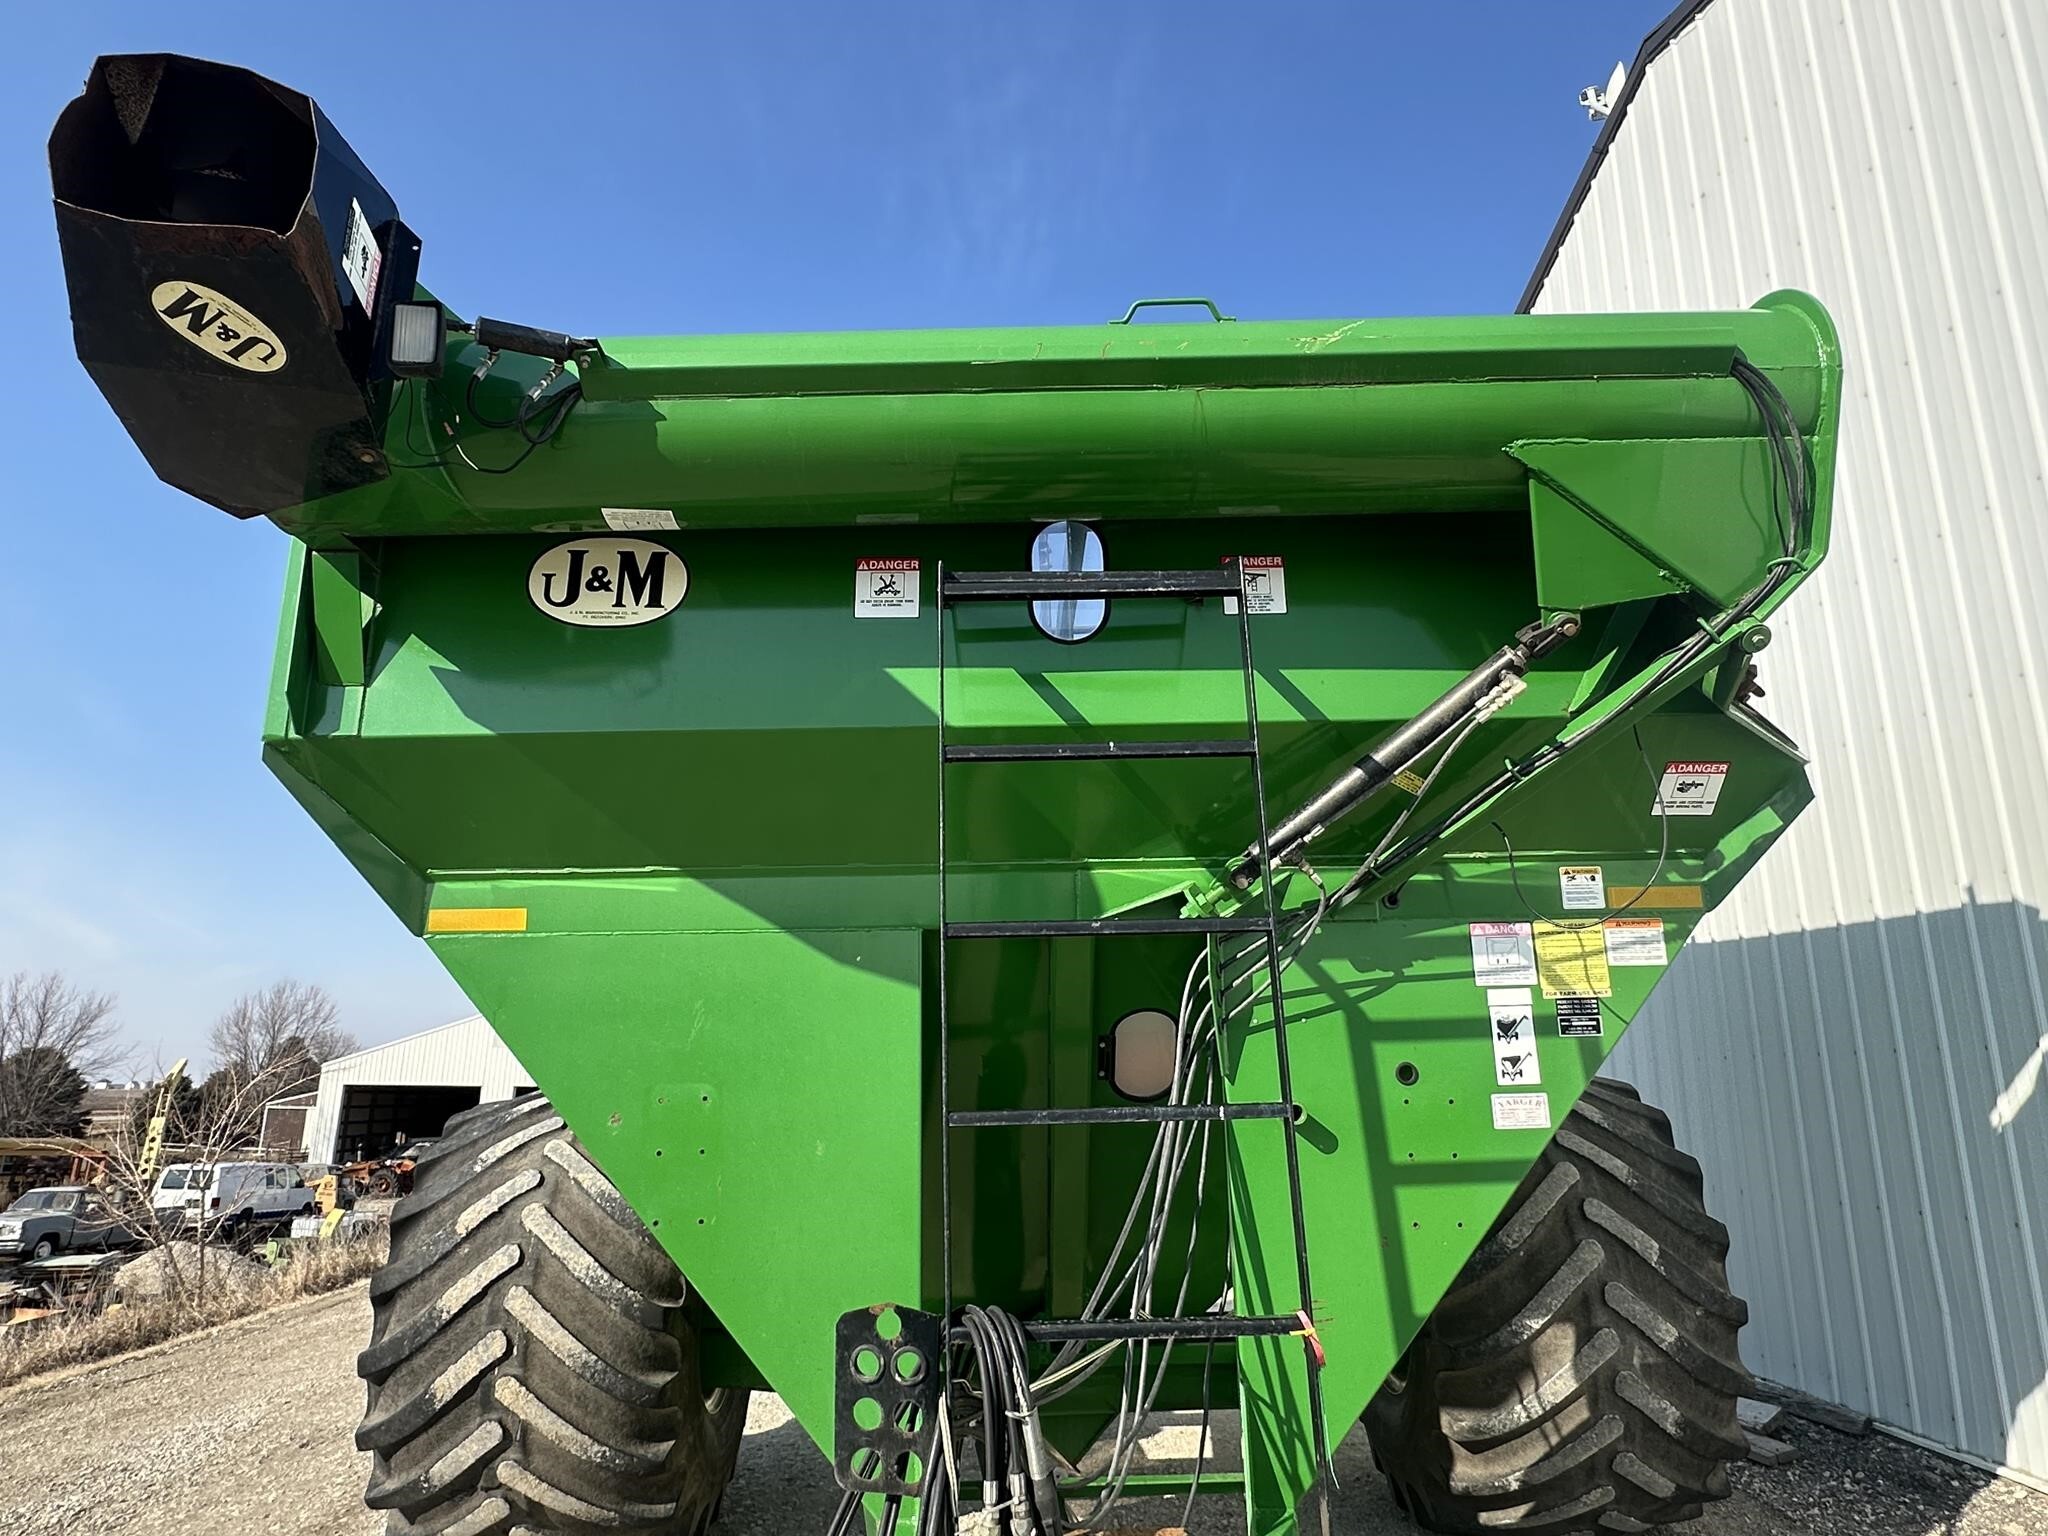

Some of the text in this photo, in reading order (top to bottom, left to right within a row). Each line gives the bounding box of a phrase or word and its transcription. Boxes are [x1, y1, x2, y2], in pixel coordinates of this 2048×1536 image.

[158, 285, 278, 366] J&M
[868, 560, 919, 570] DANGER
[1238, 556, 1282, 566] ANGER
[541, 549, 670, 609] J&M
[1677, 764, 1729, 773] DANGER
[1485, 924, 1530, 935] DANGER
